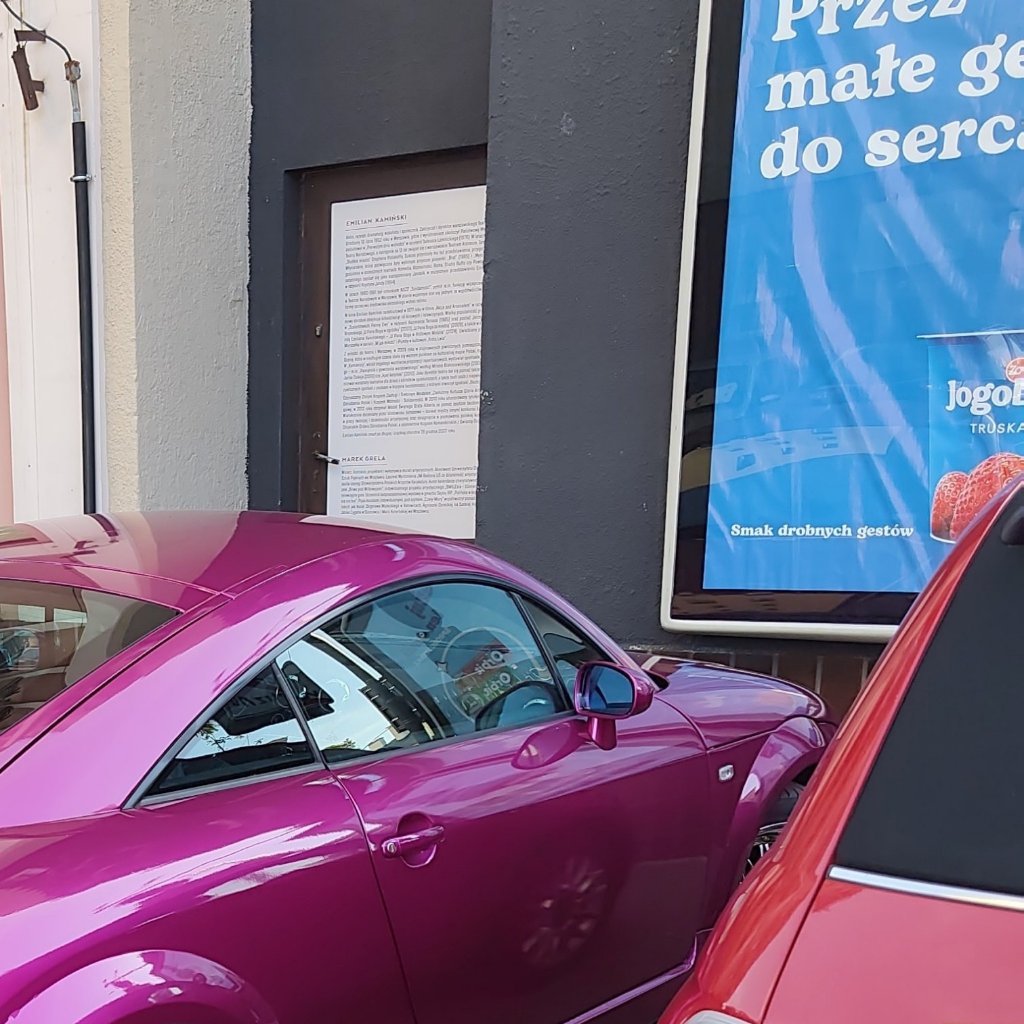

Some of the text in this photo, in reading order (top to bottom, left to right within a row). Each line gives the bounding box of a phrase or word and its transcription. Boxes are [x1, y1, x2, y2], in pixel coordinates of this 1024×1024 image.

[764, 44, 936, 111] małe
[759, 115, 1024, 179] do serc
[346, 214, 407, 227] EMILIAN KAMIŃSKI
[730, 523, 914, 539] Smak drobnych gestów
